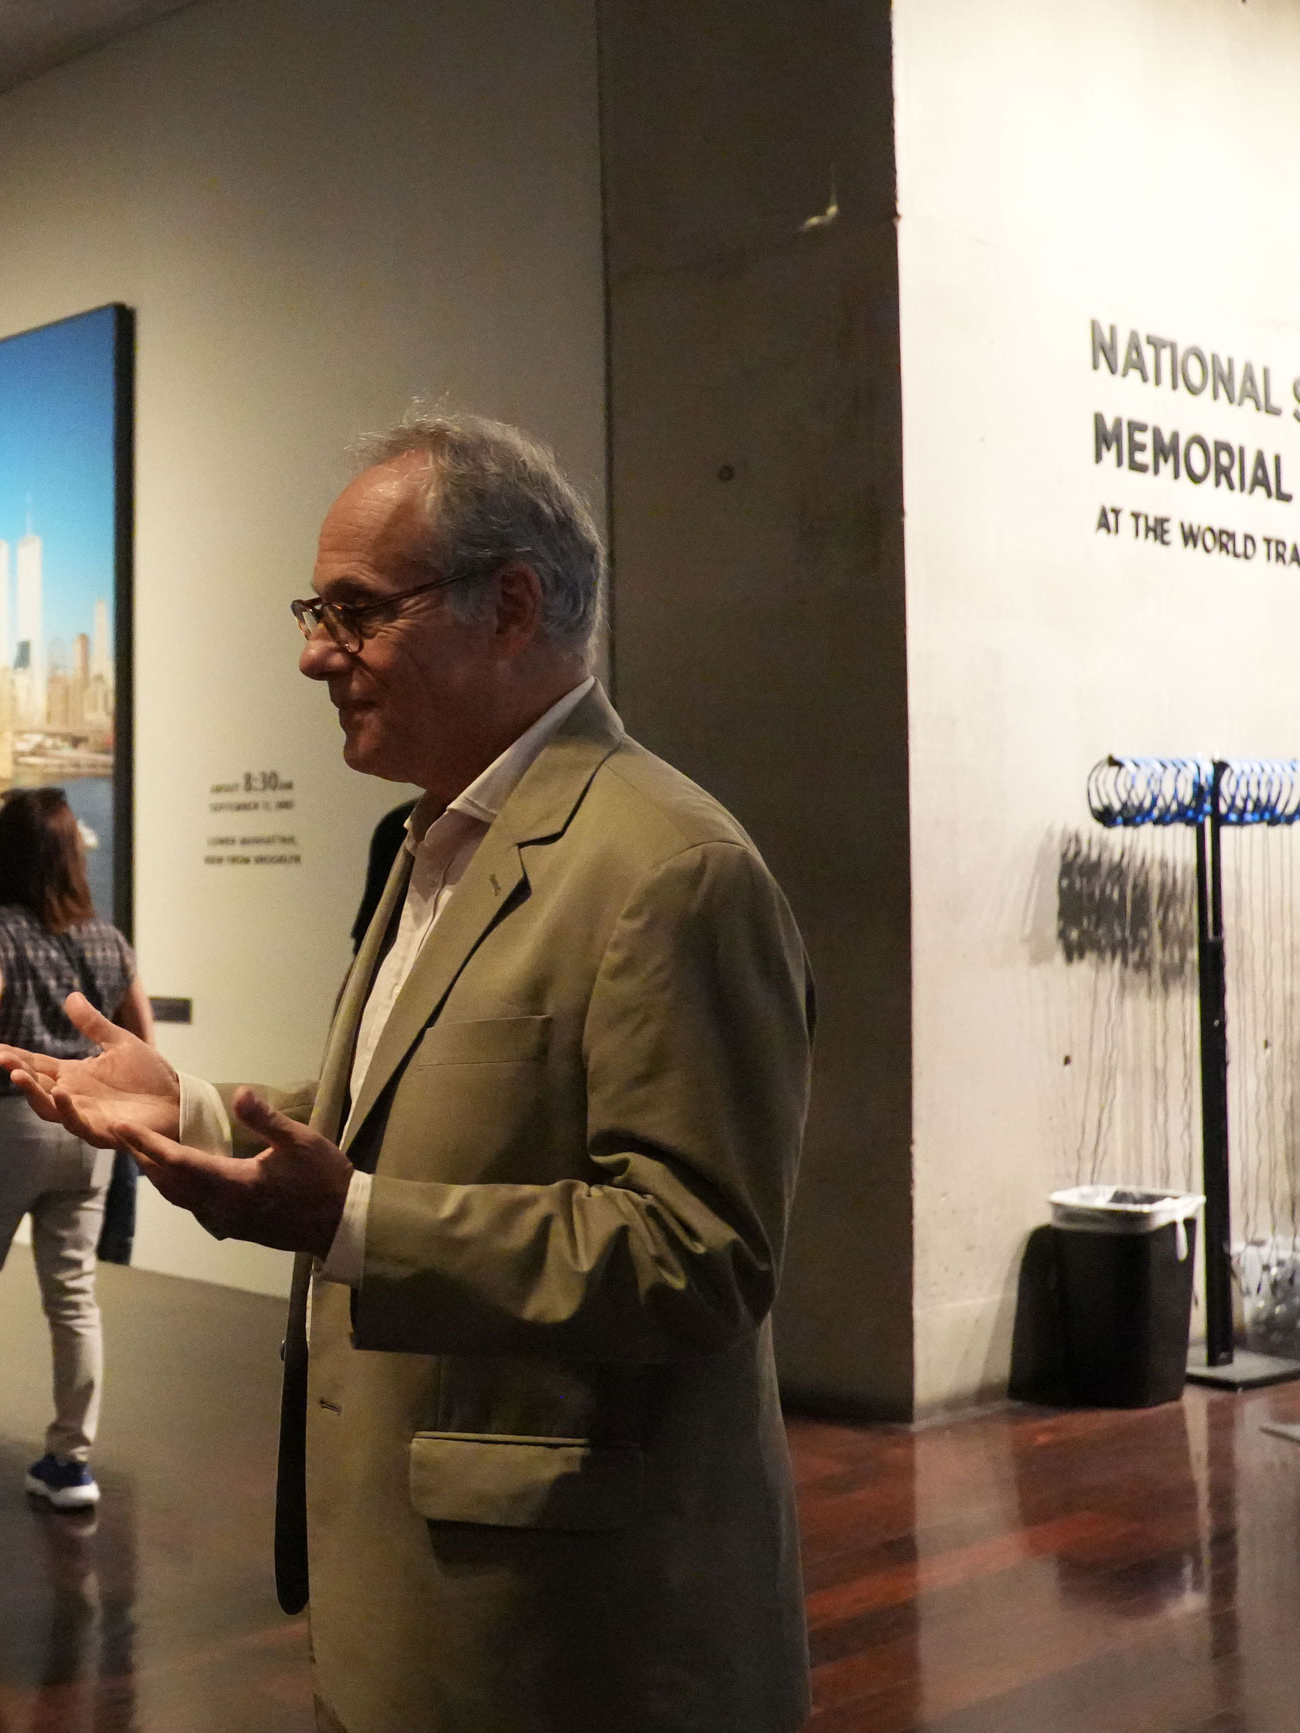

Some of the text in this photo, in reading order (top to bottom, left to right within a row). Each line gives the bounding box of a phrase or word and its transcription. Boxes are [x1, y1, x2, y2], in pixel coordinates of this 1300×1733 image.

[1091, 318, 1283, 416] NATIONAL
[1094, 411, 1293, 503] MEMORIAL
[1096, 505, 1123, 535] AT
[1130, 511, 1172, 546] THE
[1180, 521, 1257, 561] WORLD
